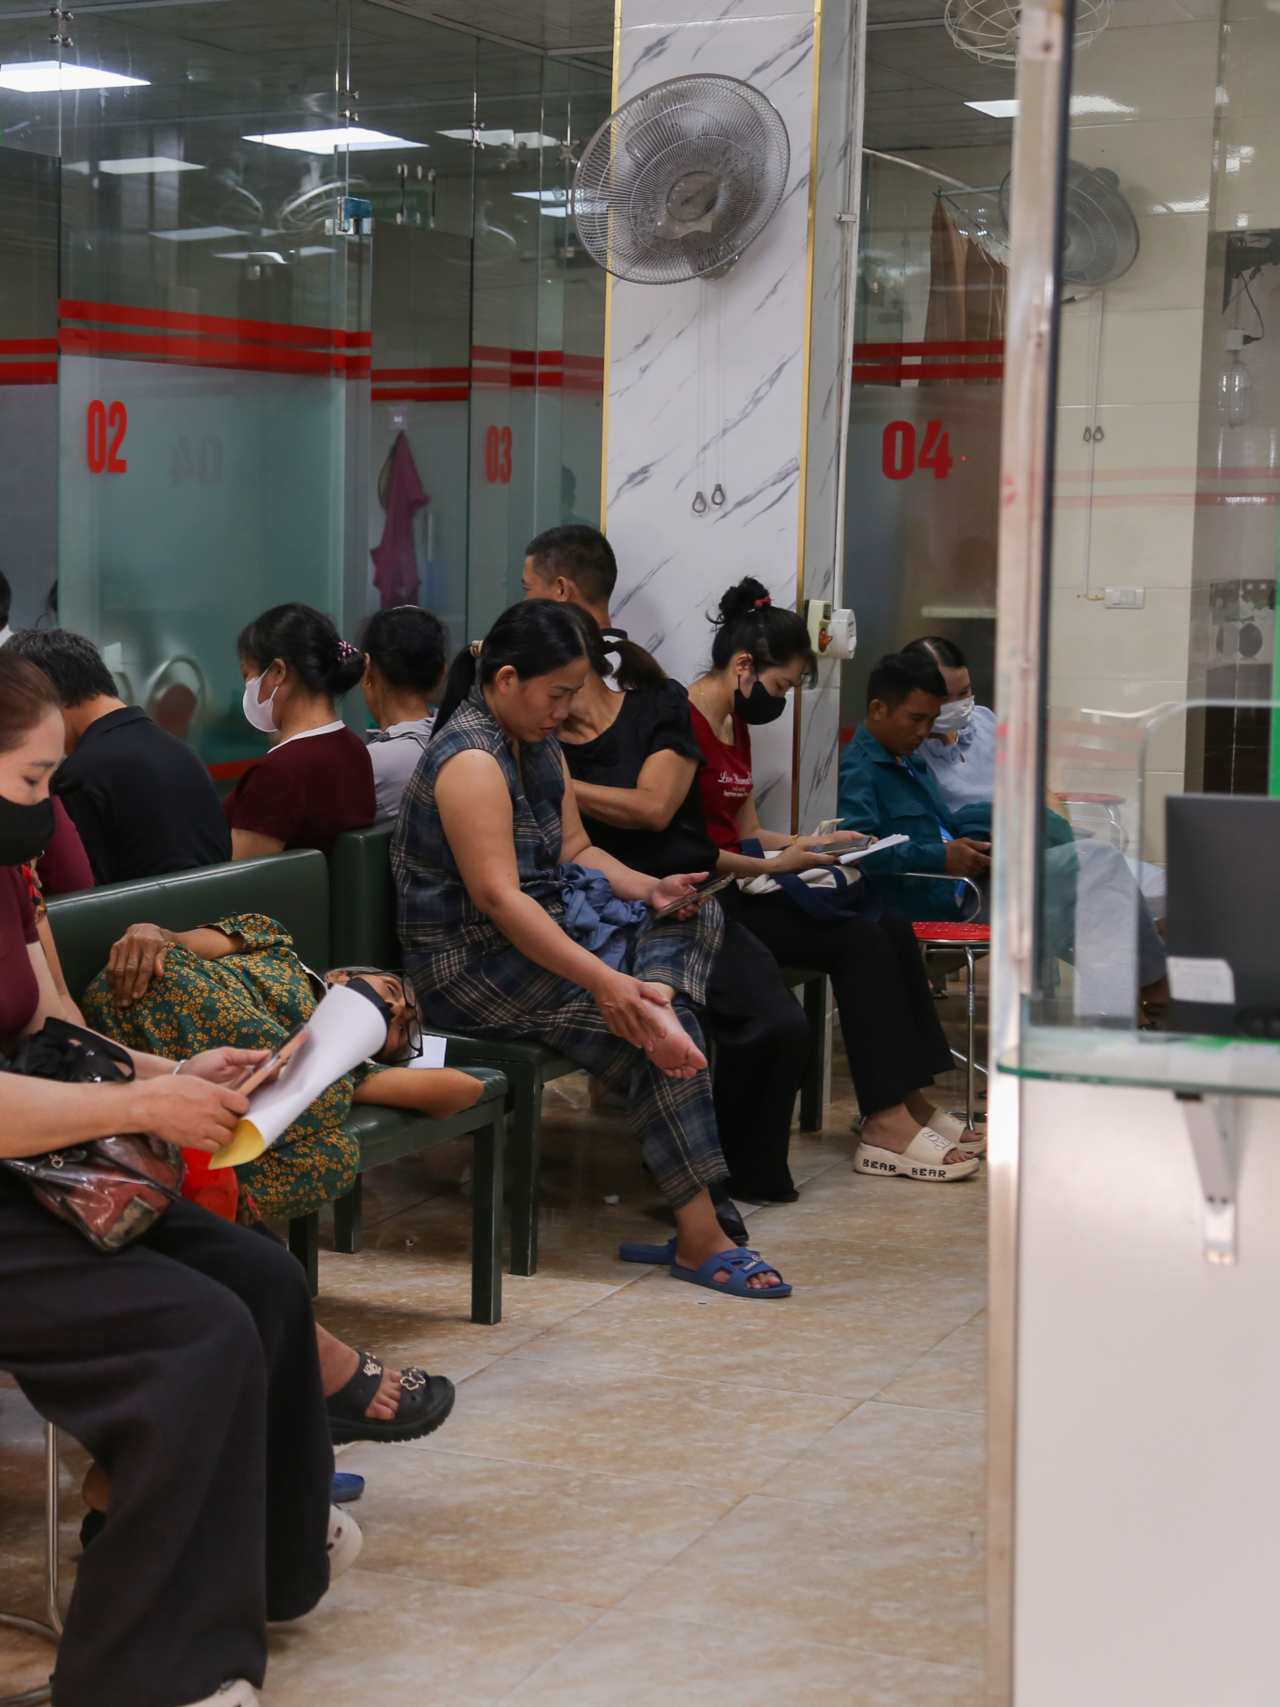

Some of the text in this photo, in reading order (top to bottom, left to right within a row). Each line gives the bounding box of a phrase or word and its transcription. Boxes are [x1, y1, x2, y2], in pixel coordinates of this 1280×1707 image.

[87, 400, 127, 473] 02
[486, 425, 512, 484] 03
[882, 420, 953, 480] 04
[863, 1158, 946, 1179] BEAR BEAR
